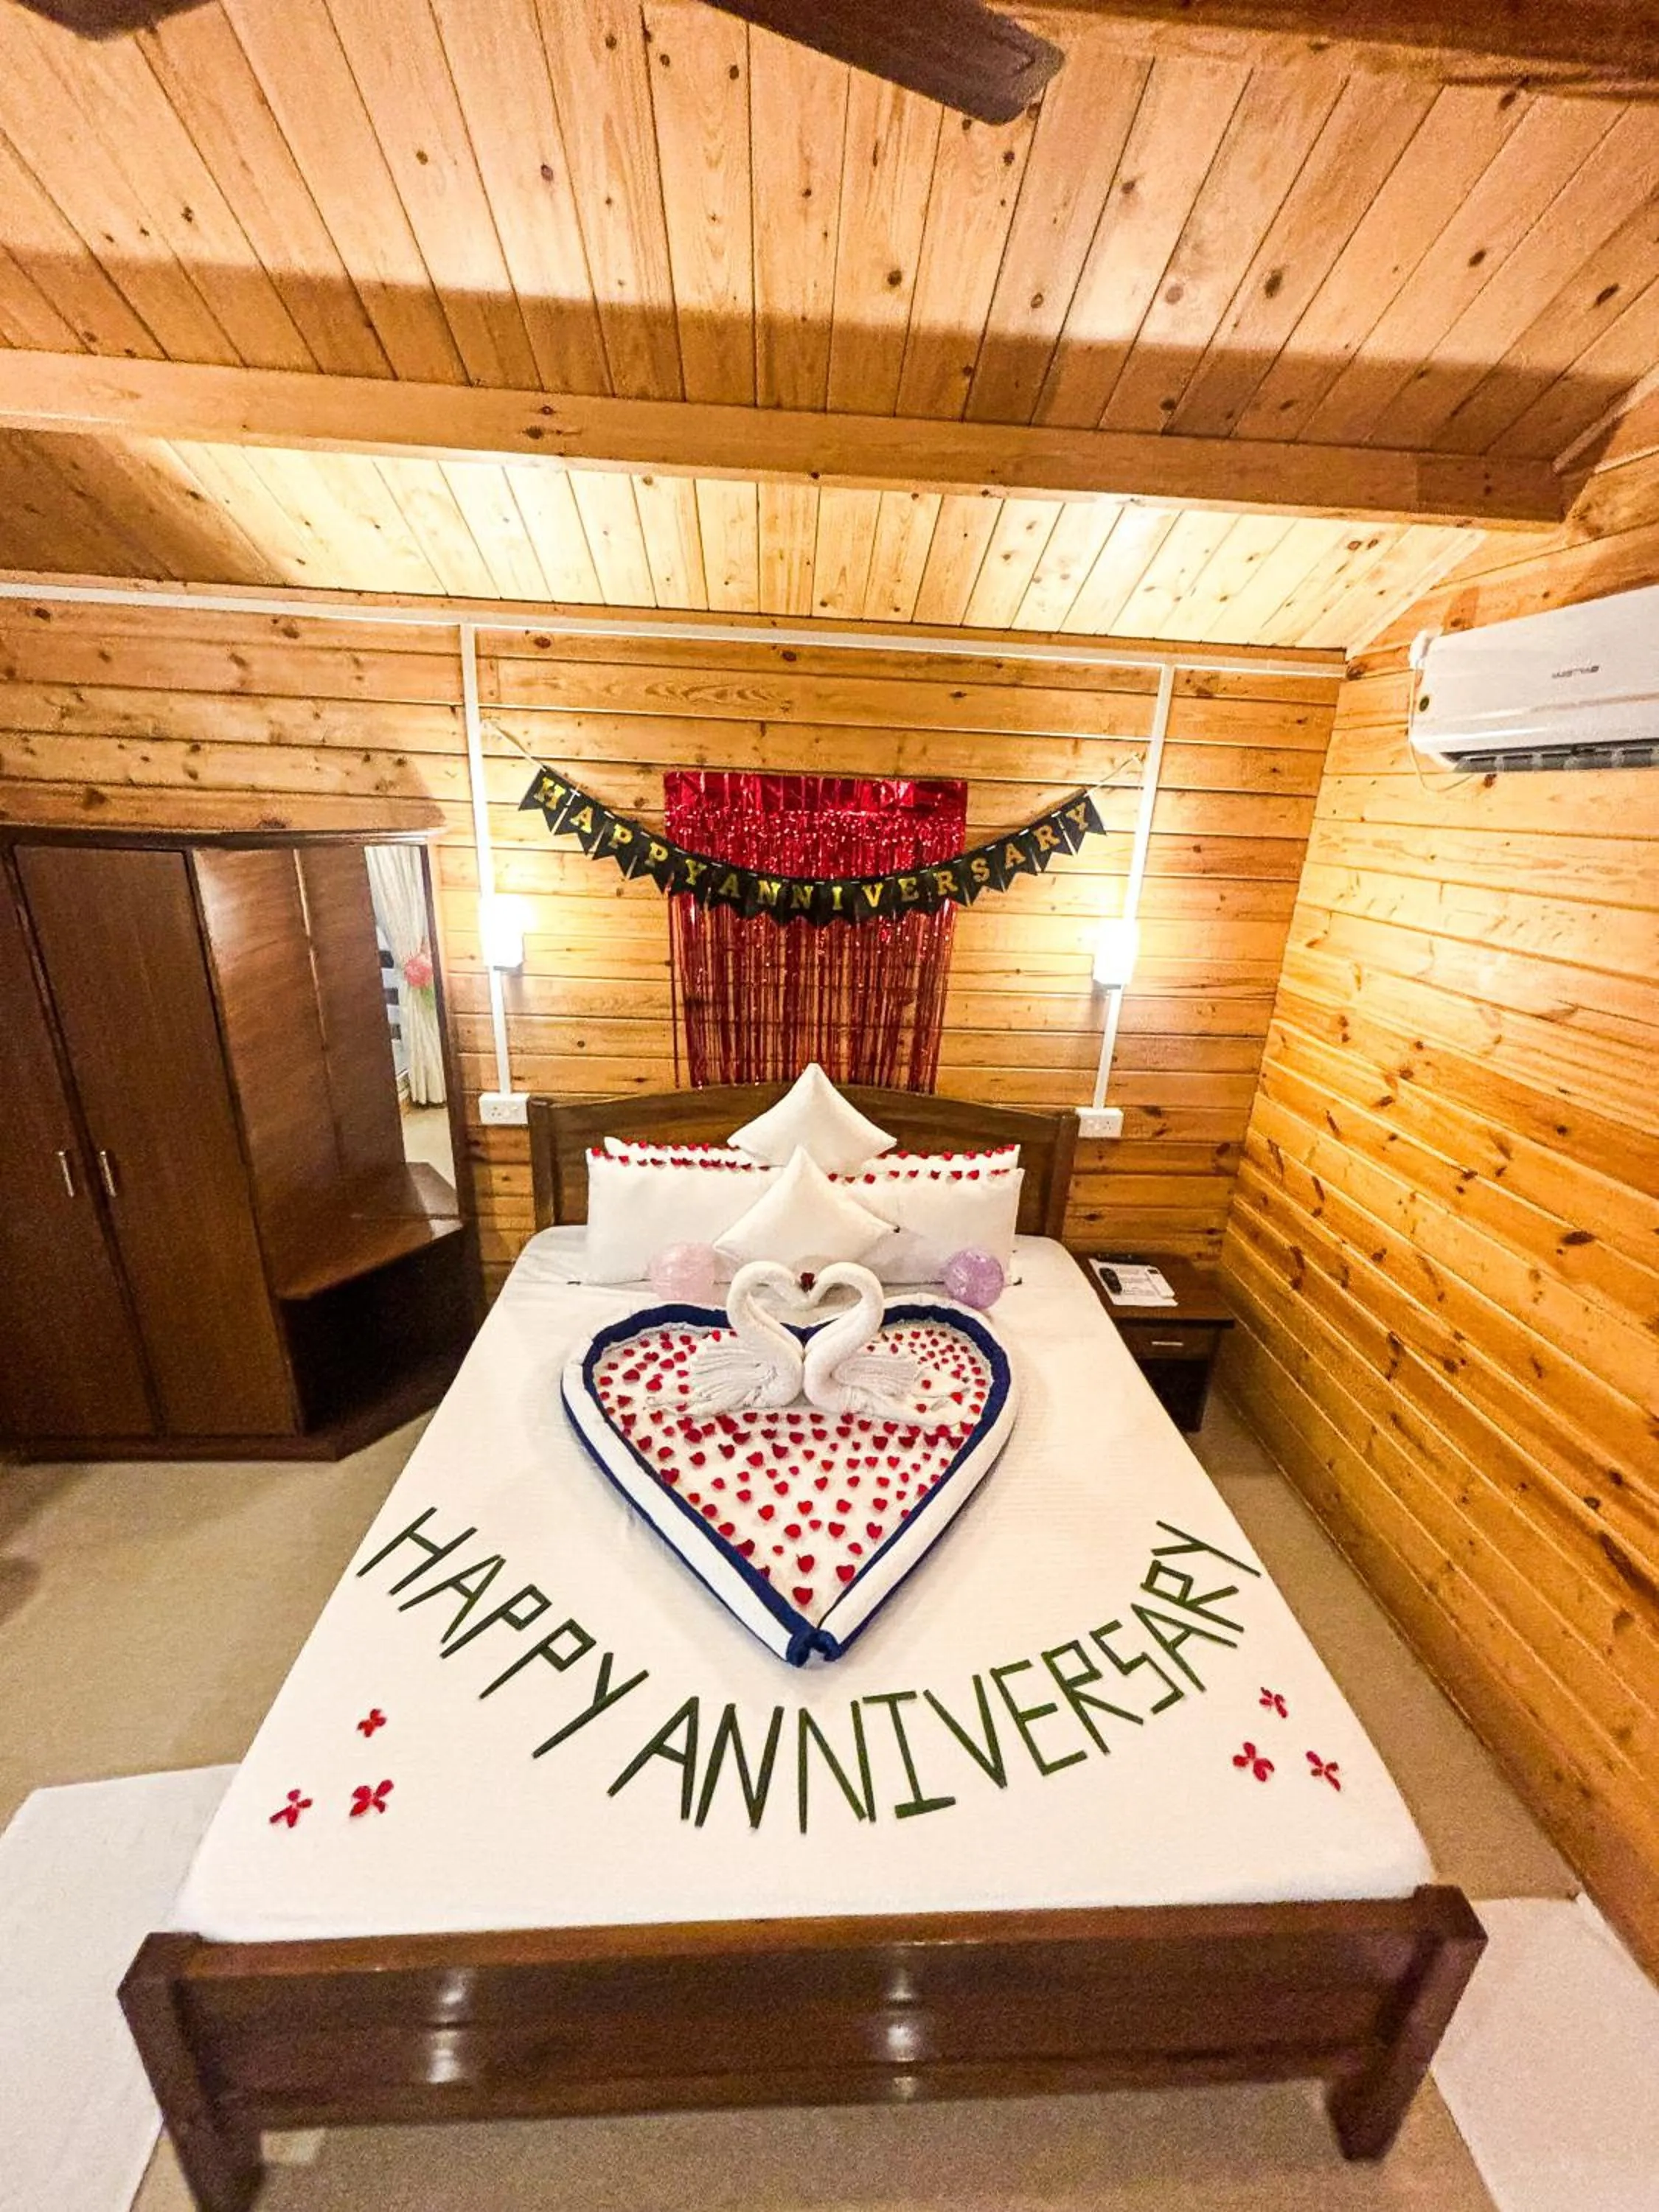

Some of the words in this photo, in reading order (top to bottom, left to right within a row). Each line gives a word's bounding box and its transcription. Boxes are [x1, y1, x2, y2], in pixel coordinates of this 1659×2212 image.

[534, 777, 706, 886] HAPPY
[357, 1506, 649, 1759] HAPPY
[607, 1520, 1262, 1834] ANNIVERSARY
